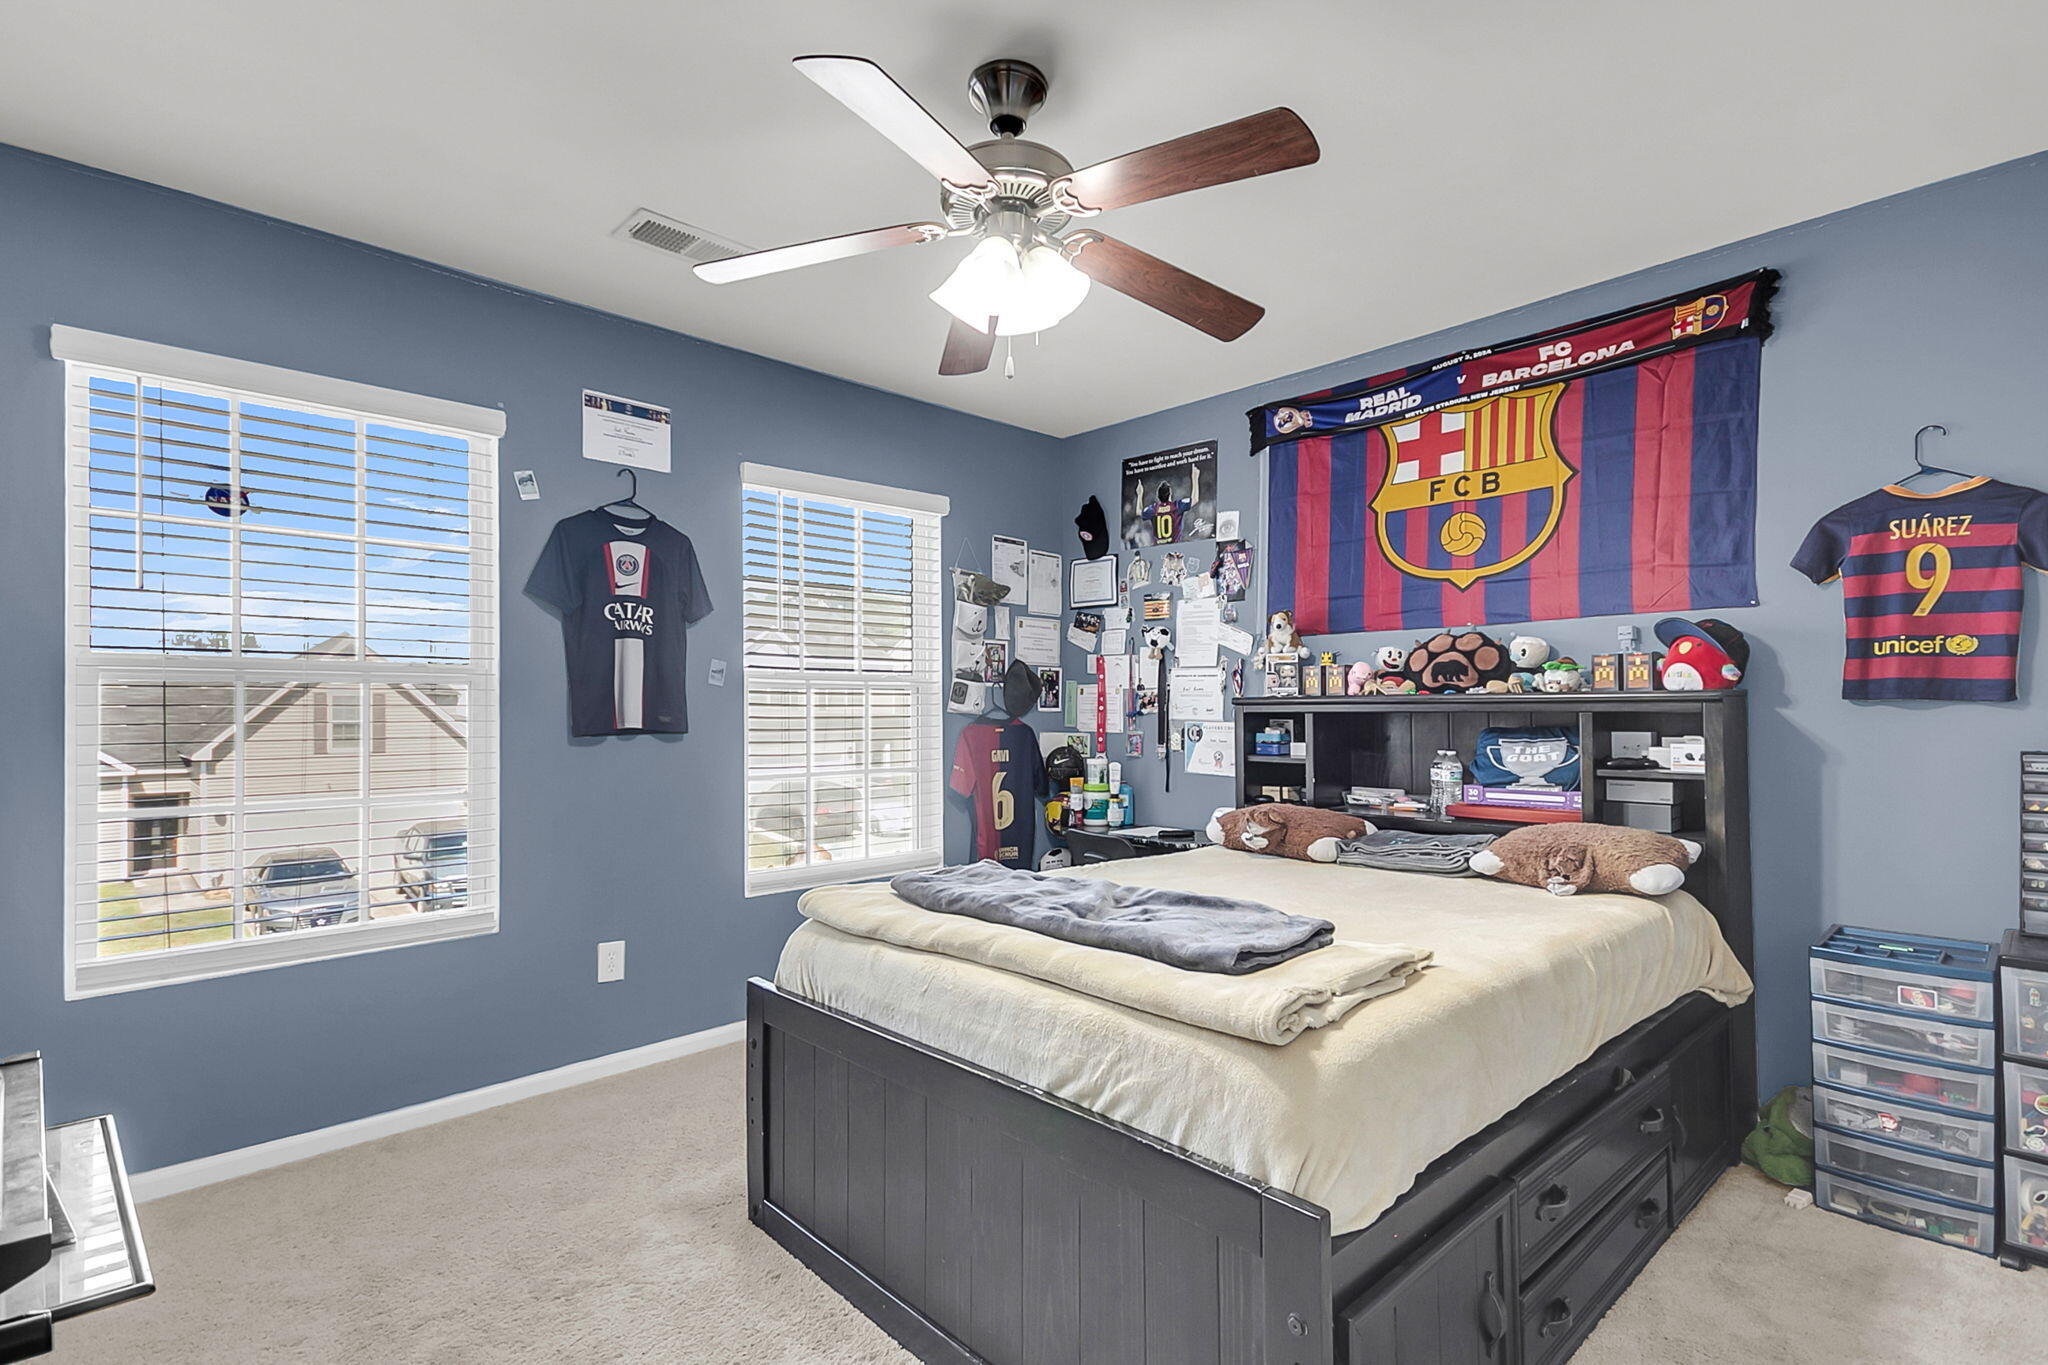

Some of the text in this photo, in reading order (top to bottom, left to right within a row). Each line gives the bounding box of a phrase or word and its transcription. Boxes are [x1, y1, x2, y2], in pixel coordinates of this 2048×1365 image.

[1432, 354, 1463, 371] AUGUST
[1473, 348, 1493, 360] 2024
[1538, 341, 1573, 362] FC
[1481, 340, 1636, 388] BARCELONA
[1456, 374, 1468, 386] V
[1359, 387, 1411, 411] REAL
[1470, 390, 1488, 401] NEW
[1488, 384, 1521, 398] JERSEY
[1344, 394, 1422, 423] MADRID
[1430, 471, 1501, 502] FCB
[208, 495, 249, 506] NAA
[1157, 514, 1173, 538] 10
[1889, 513, 1973, 540] SUÁREZ
[1906, 543, 1952, 616] 9
[1873, 635, 1945, 656] unicef
[991, 749, 1010, 763] GAVI
[1506, 751, 1561, 763] GOAT
[1513, 744, 1551, 755] THE
[992, 771, 1015, 831] 6
